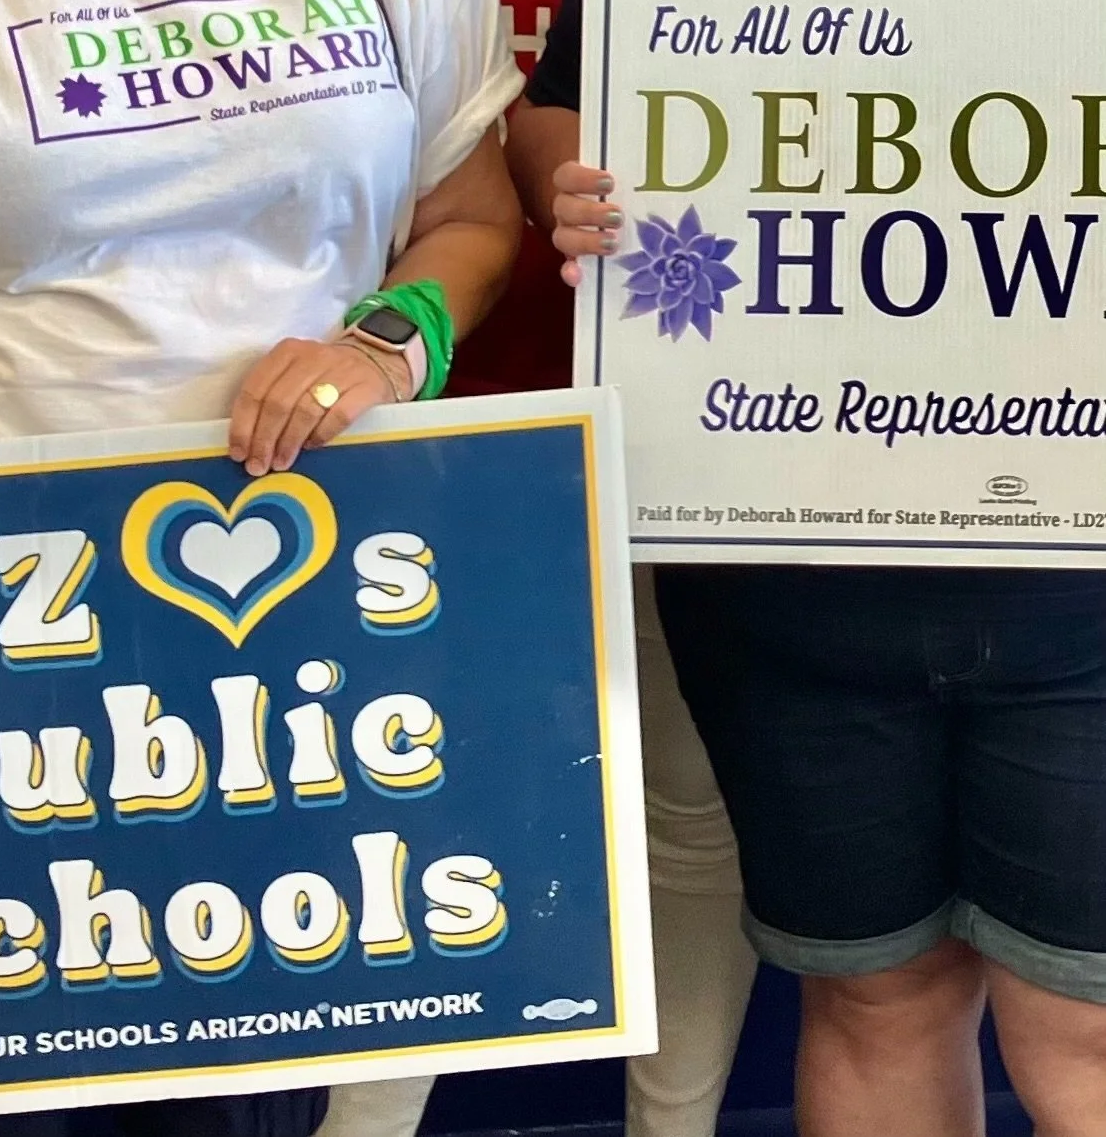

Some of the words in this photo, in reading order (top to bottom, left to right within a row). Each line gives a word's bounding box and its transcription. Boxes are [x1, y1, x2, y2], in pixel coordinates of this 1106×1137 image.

[50, 10, 73, 24] For
[76, 8, 94, 22] All
[97, 6, 111, 20] Of
[114, 6, 131, 20] Us
[648, 4, 723, 57] For
[730, 3, 791, 56] All
[802, 4, 855, 56] Of
[858, 7, 913, 57] Us
[117, 29, 383, 109] HOWARD
[210, 105, 247, 122] State
[249, 82, 350, 114] Representative
[351, 80, 365, 96] LD
[367, 79, 378, 95] 27
[699, 376, 825, 434] State
[835, 378, 1106, 449] Representa
[637, 505, 672, 522] Paid
[676, 506, 701, 522] for
[704, 505, 724, 526] by
[727, 507, 796, 523] Deborah
[799, 508, 864, 524] Howard
[867, 508, 892, 525] for
[895, 509, 936, 525] State
[939, 510, 1060, 529] Representative
[1072, 512, 1106, 528] LD2
[35, 1021, 180, 1054] SCHOOLS
[331, 991, 485, 1027] NETWORK
